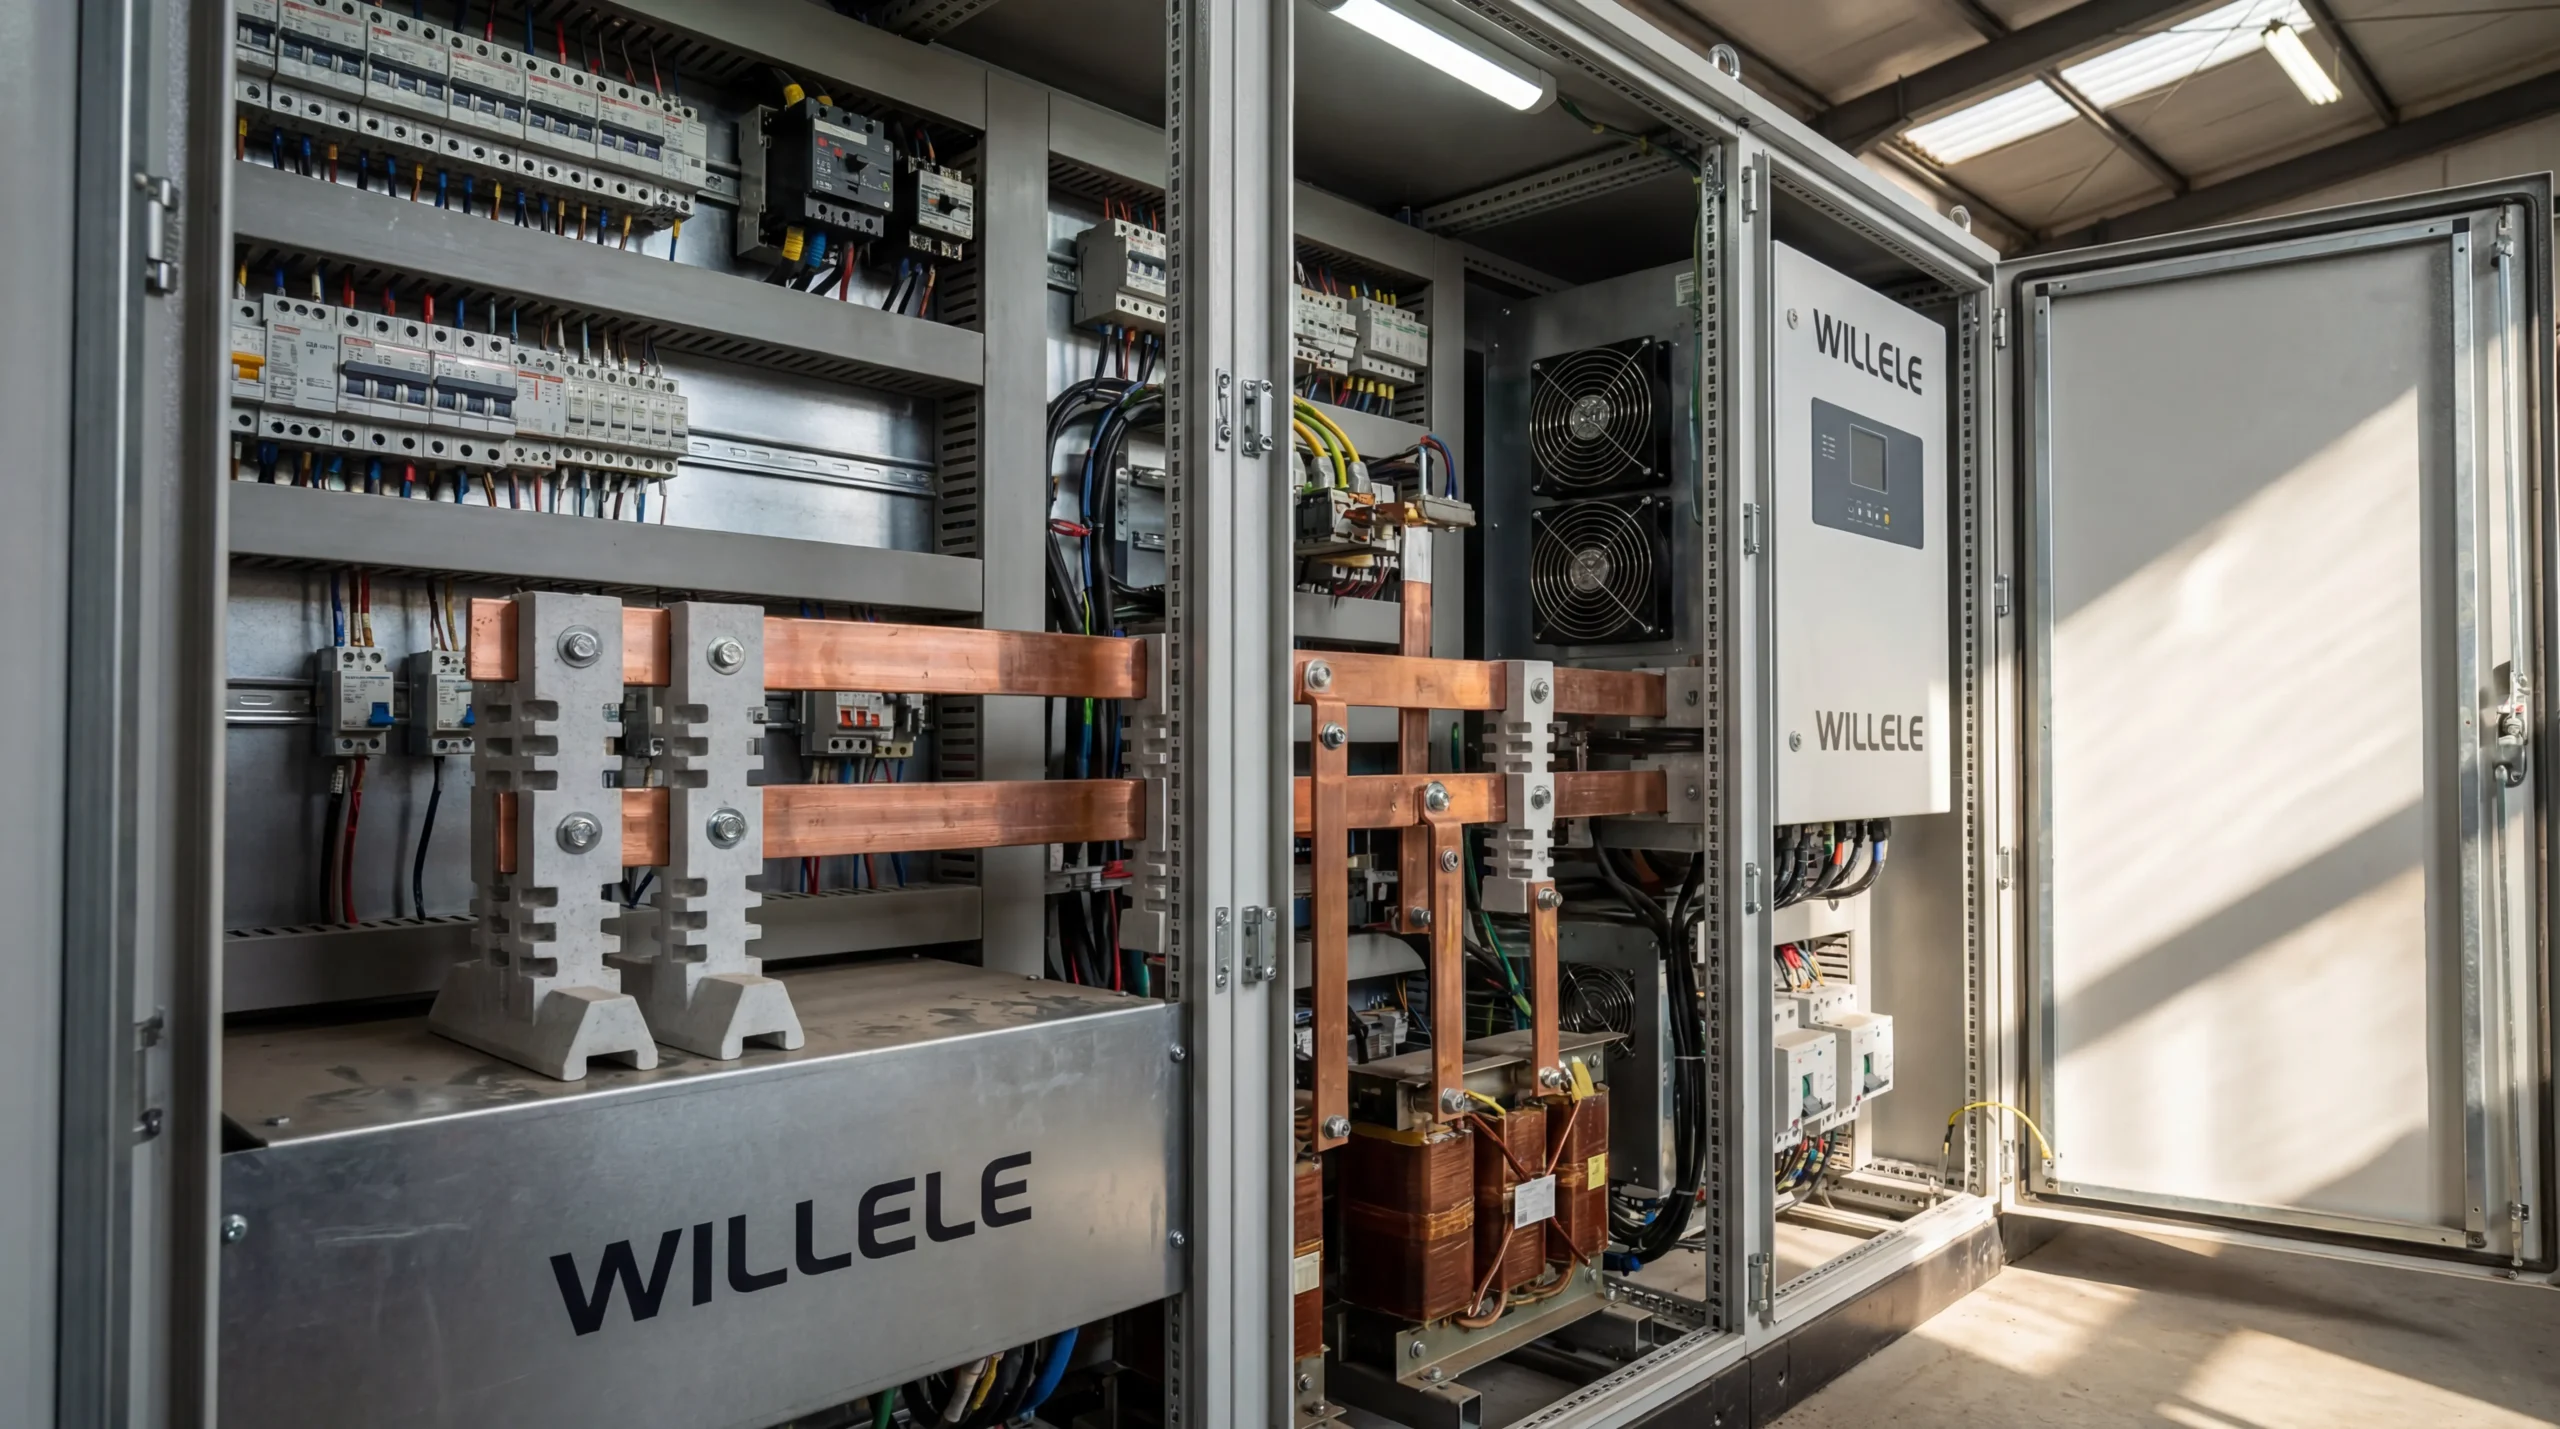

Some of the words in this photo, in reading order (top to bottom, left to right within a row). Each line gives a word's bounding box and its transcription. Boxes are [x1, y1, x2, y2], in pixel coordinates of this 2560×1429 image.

[1813, 308, 1923, 396] WILLELE
[1815, 709, 1924, 752] WILLELE
[549, 1151, 1032, 1337] WILLELE
